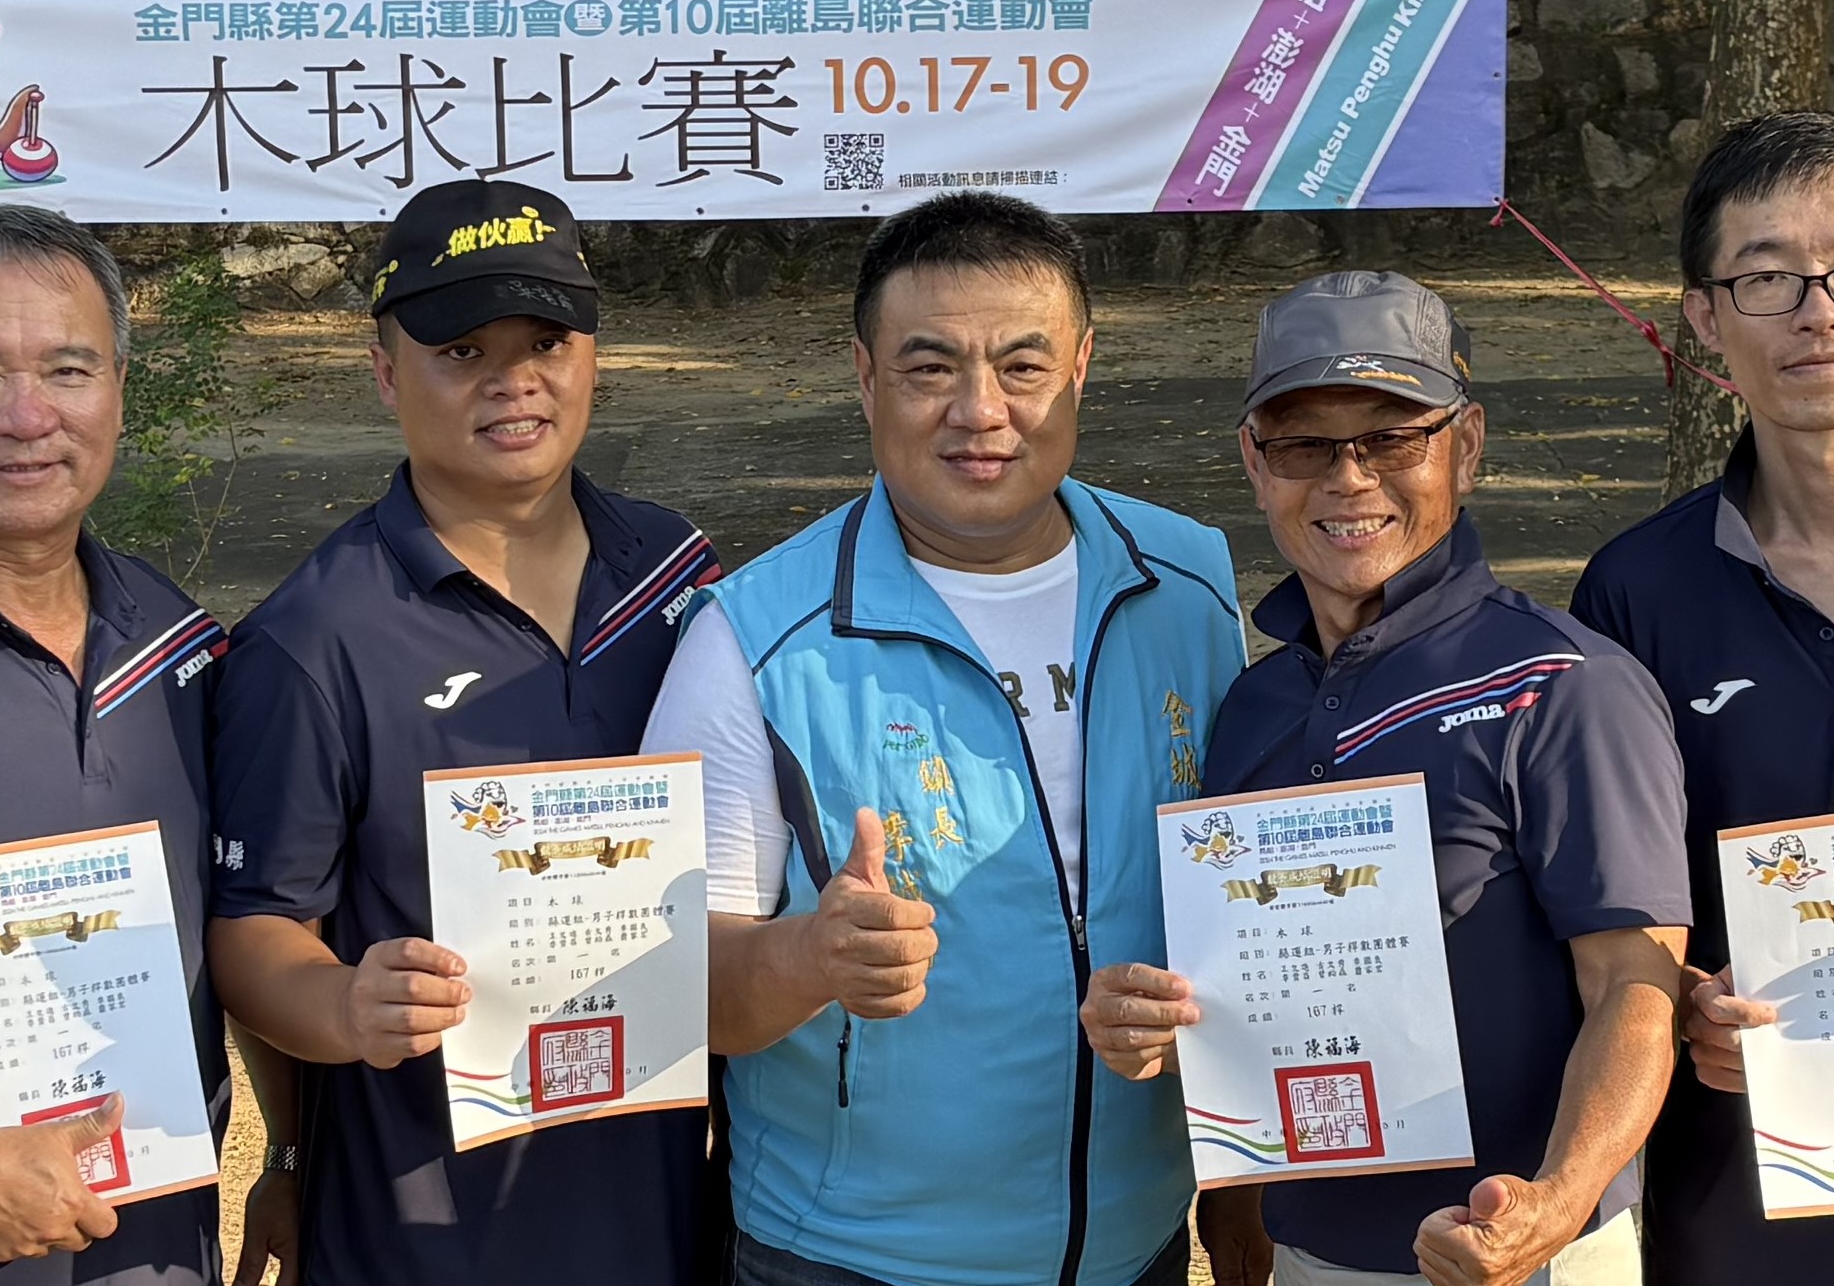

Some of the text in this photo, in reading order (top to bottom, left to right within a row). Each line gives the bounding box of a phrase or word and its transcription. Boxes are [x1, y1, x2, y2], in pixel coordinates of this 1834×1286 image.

[141, 49, 799, 192] 木球比賽
[824, 53, 1090, 116] 10.17-19
[1298, 121, 1352, 198] Matsu
[1340, 26, 1403, 120] Penghu
